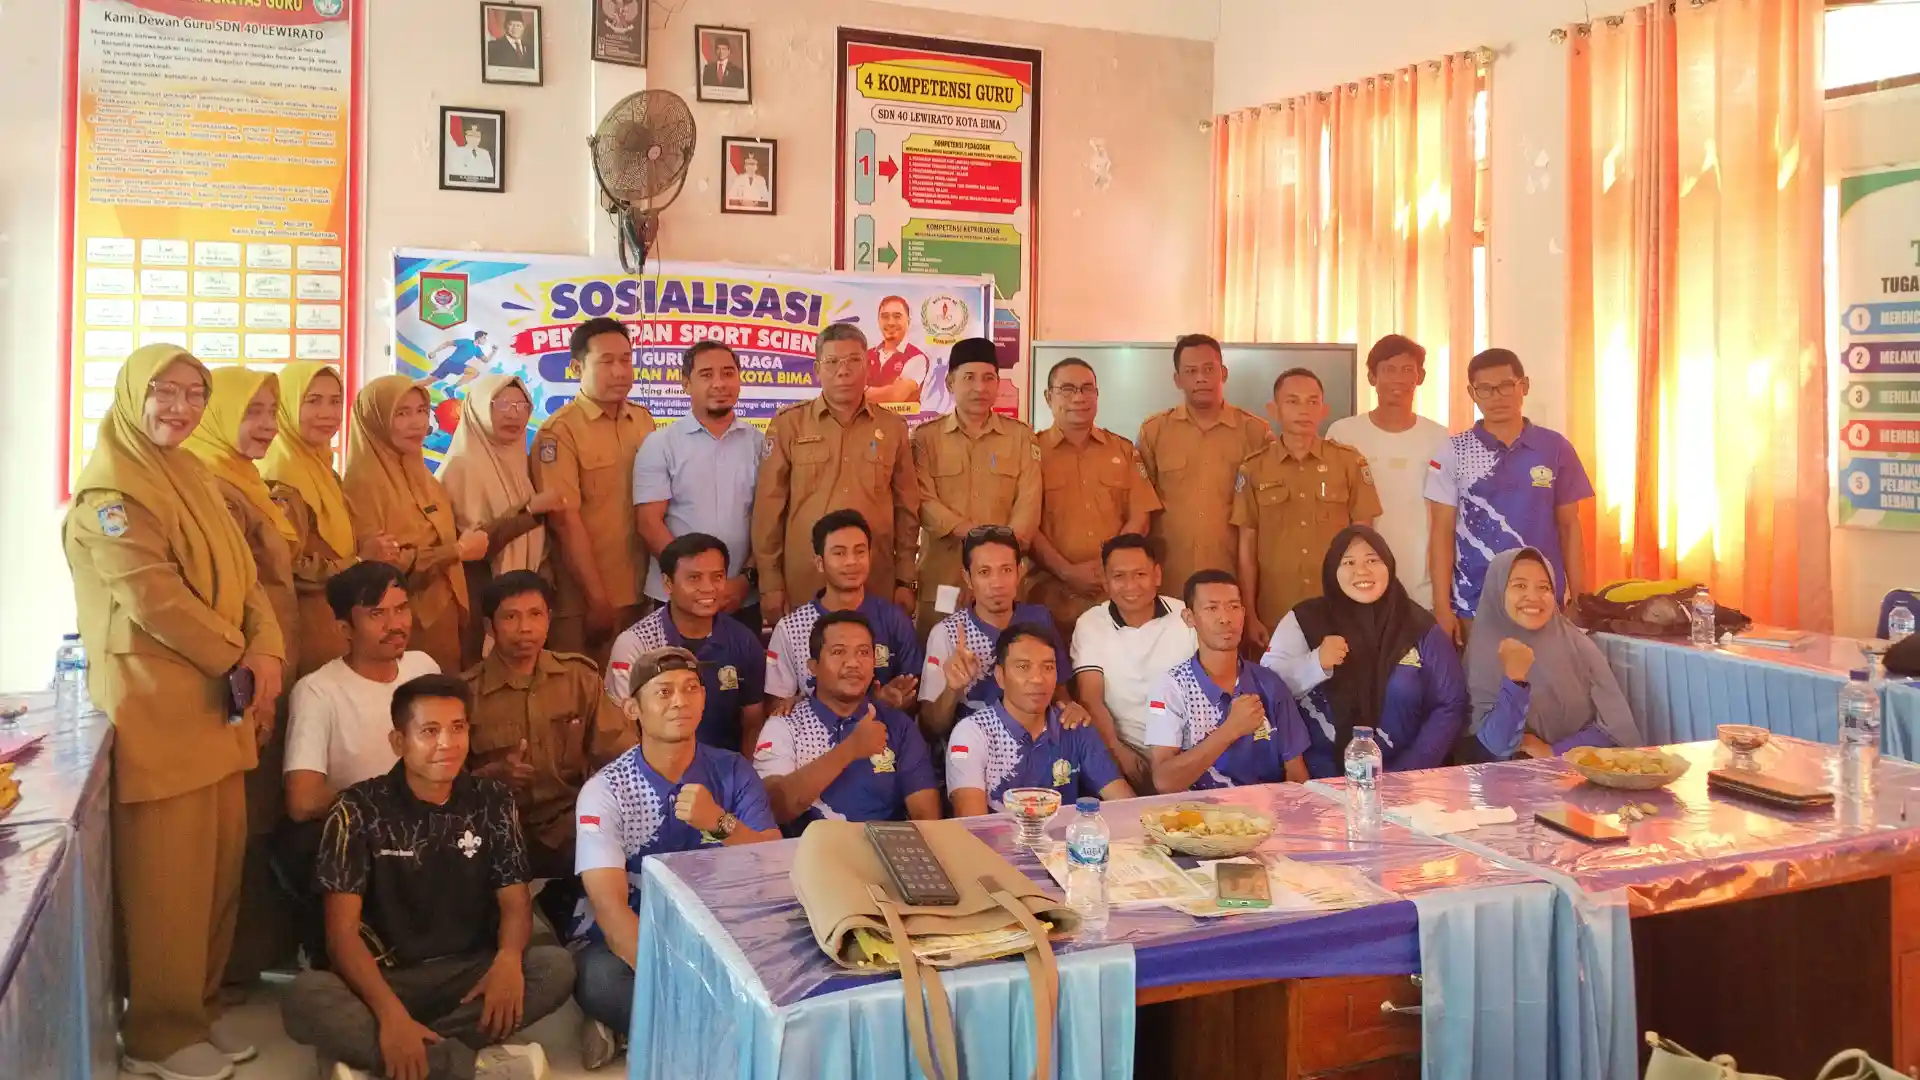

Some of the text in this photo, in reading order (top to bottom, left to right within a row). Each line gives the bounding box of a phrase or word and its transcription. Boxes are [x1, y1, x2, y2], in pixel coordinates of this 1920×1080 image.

[104, 10, 324, 41] Kami Dewan Guru SDN 40 LEWIRATO
[864, 72, 1015, 104] 4 KOMPETENSI GURU
[878, 108, 1002, 130] SDN 40 LEWIRATO KOTA BIMA
[934, 140, 964, 149] KOMPETENSI
[858, 155, 870, 176] 1
[926, 223, 1001, 235] KOMPETENSI KEPRIBADIAN
[857, 241, 871, 266] 2
[1881, 275, 1920, 294] TUGA
[550, 279, 824, 327] SOSIALISASI
[1858, 310, 1920, 326] 1 MERENC
[679, 322, 752, 347] SPORT
[757, 328, 818, 353] SCIEN
[1855, 350, 1920, 365] 2 MELAKU
[776, 371, 813, 386] BIMA
[1855, 390, 1863, 403] 3
[1855, 429, 1920, 444] 4 MEMBI
[1855, 476, 1863, 490] 5
